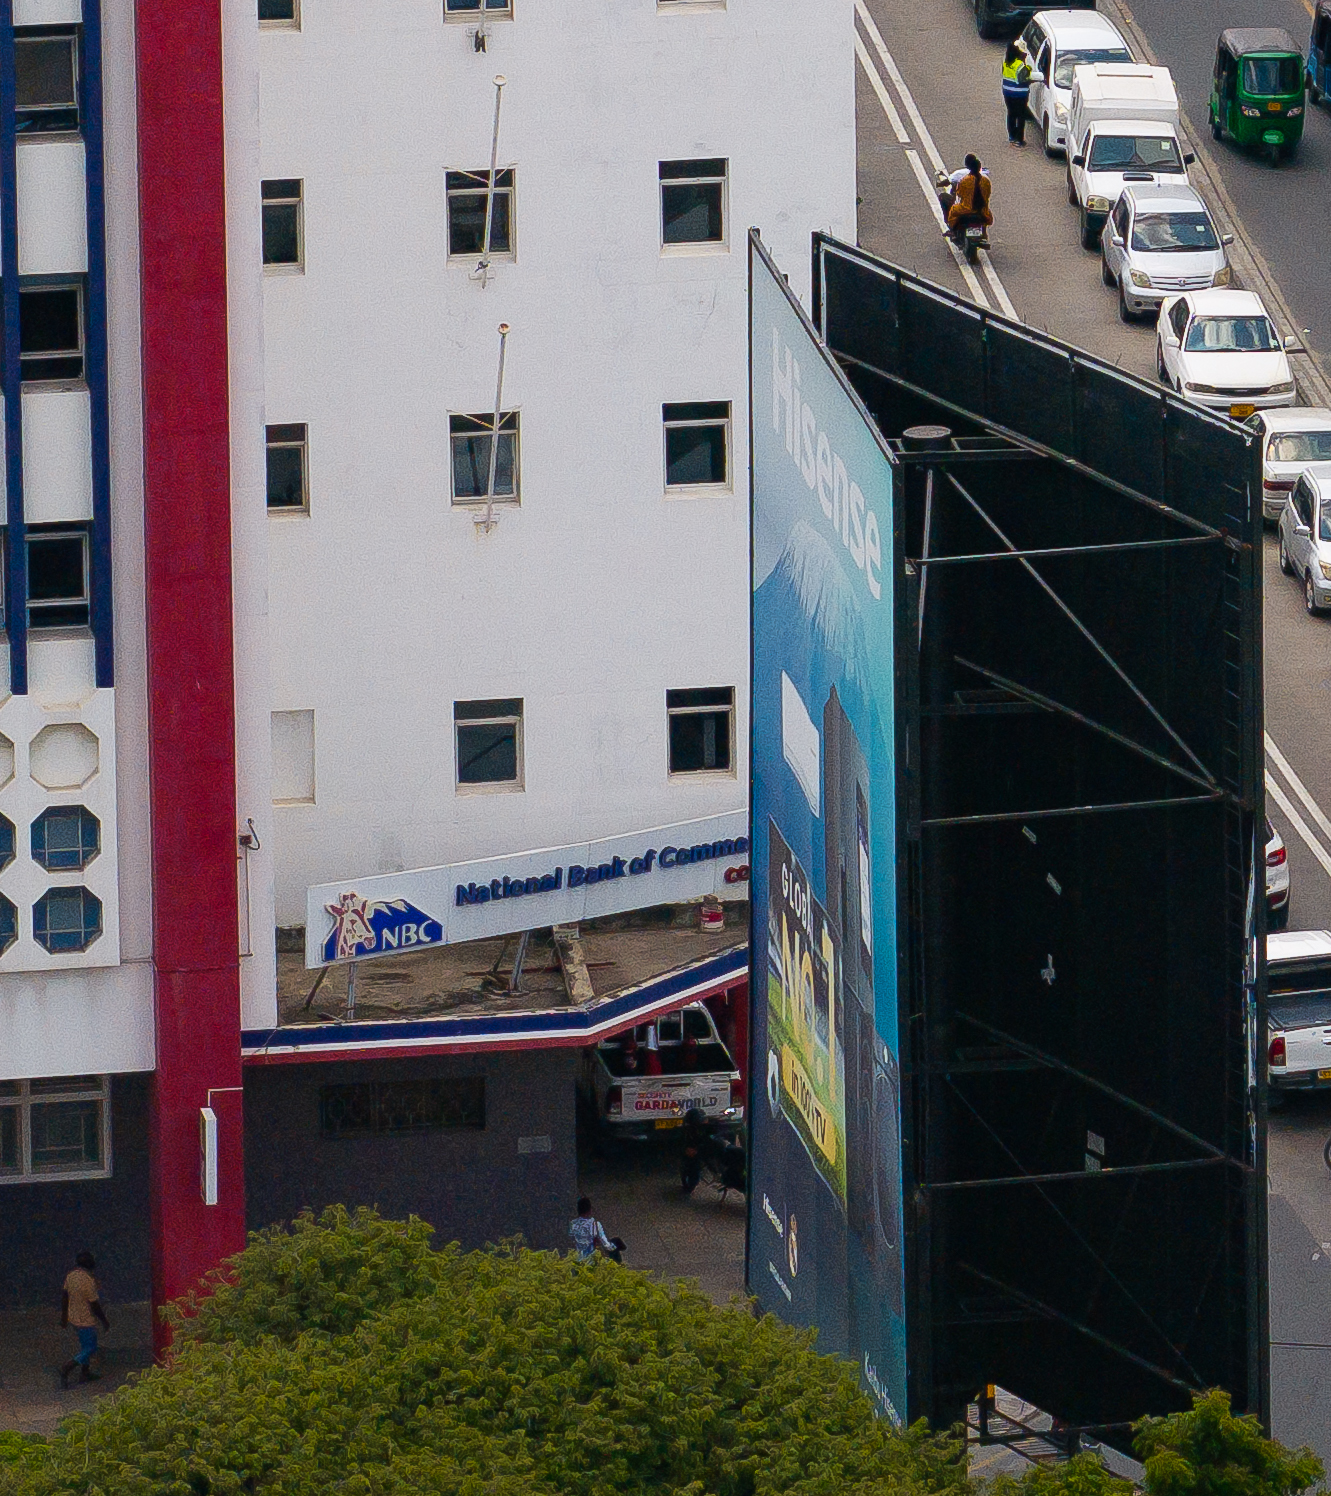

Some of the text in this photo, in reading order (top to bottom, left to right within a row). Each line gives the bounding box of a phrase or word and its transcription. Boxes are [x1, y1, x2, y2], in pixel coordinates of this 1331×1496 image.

[772, 326, 882, 601] Hisense
[455, 836, 749, 906] National Bank of Comme
[381, 919, 434, 950] NBC
